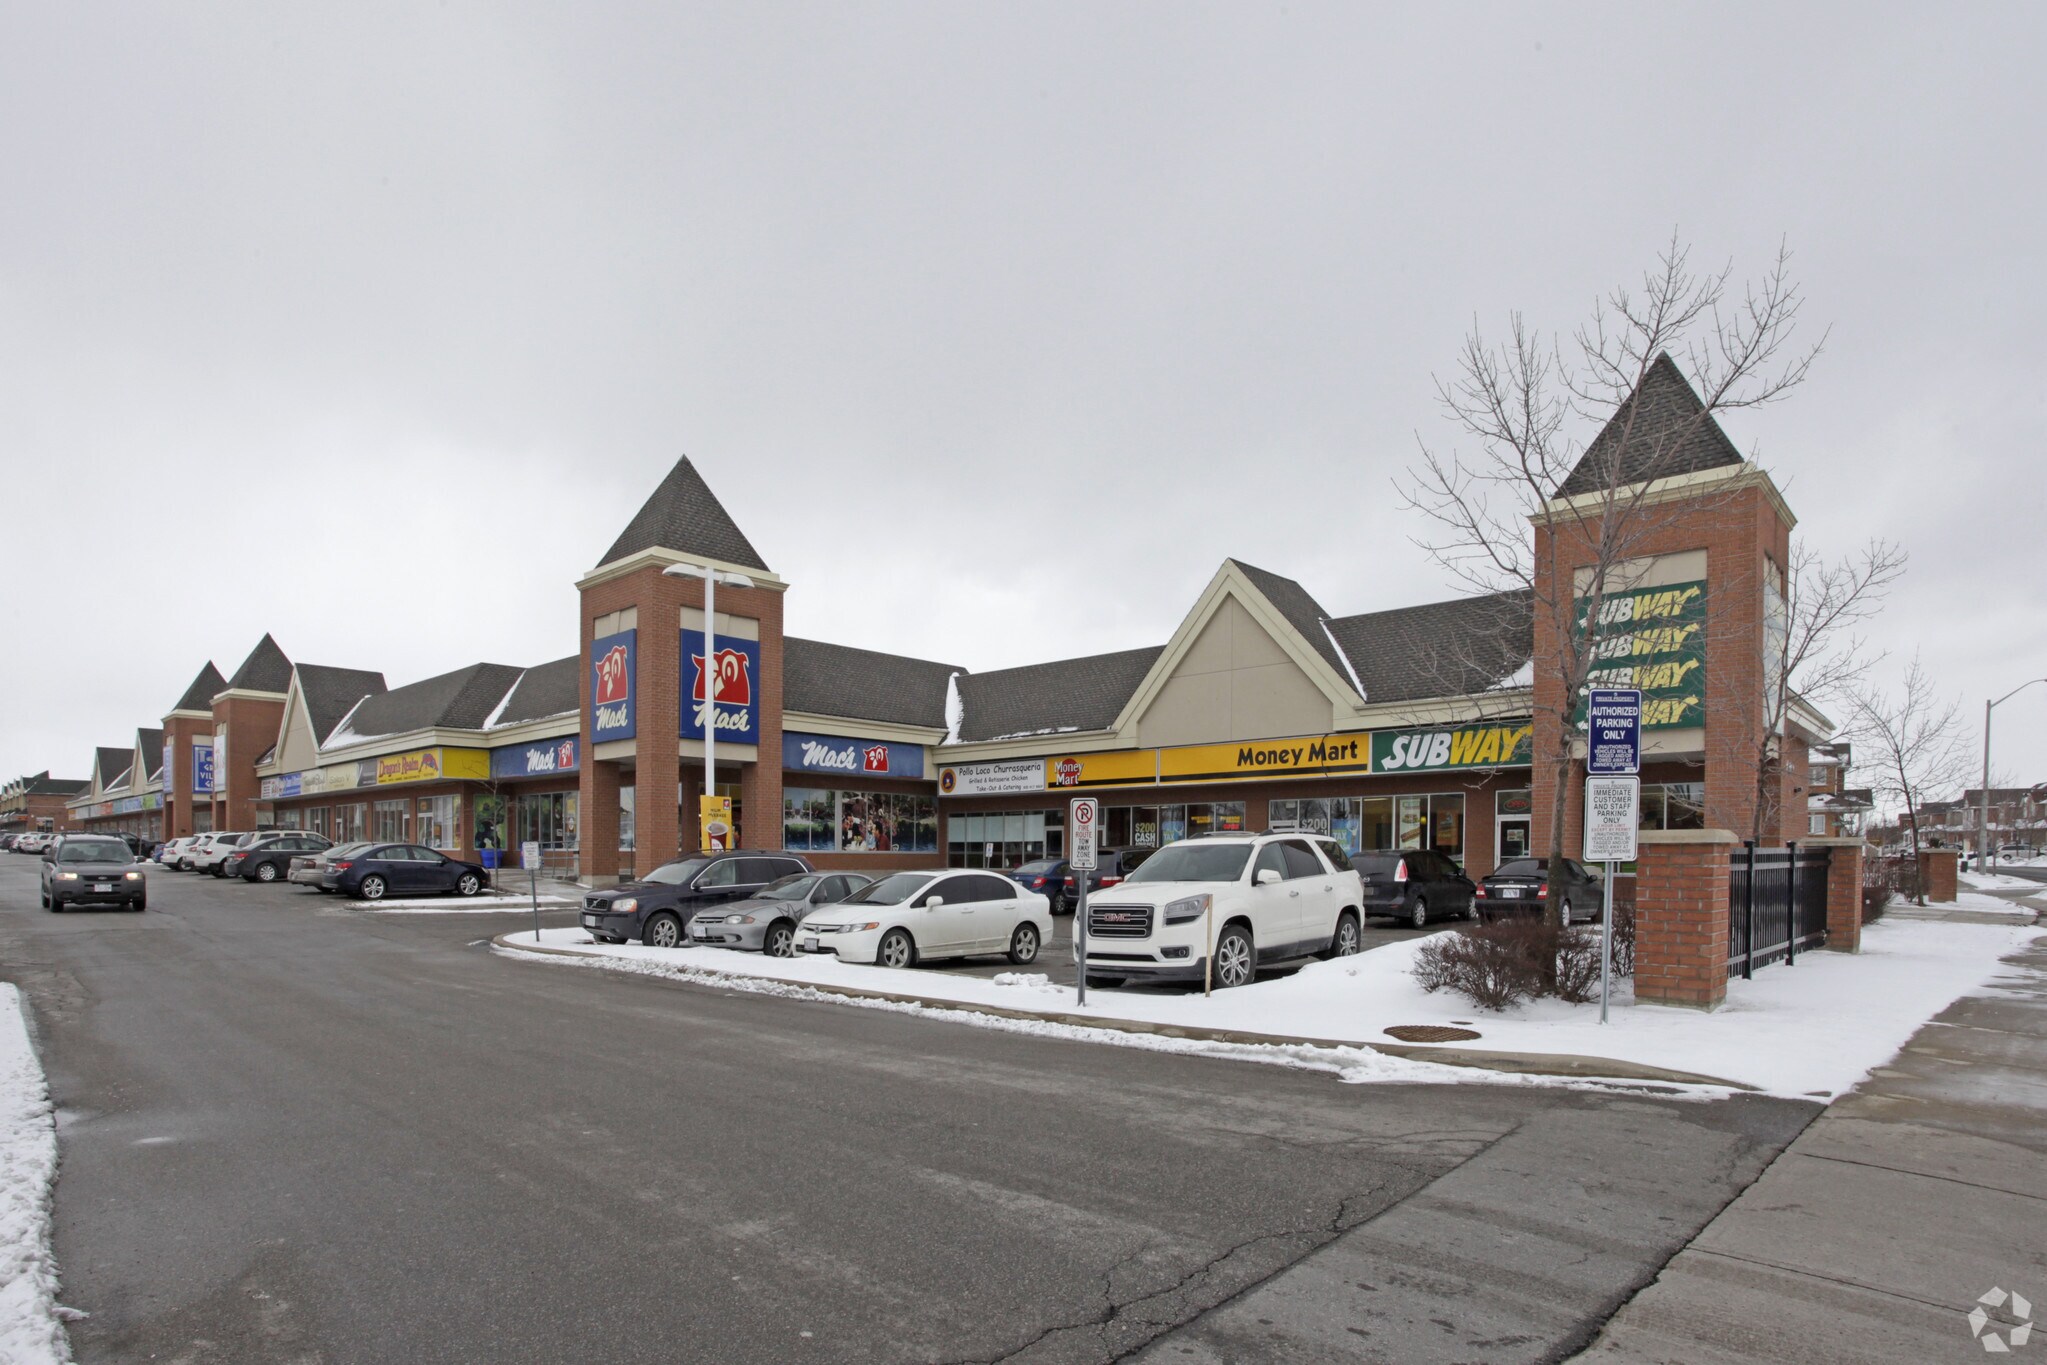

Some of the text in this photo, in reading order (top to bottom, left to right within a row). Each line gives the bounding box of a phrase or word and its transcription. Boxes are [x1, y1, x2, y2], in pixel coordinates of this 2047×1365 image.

[595, 703, 628, 731] Mac's
[692, 703, 750, 732] Mac's
[1592, 707, 1638, 716] AUTHORIZED
[1596, 719, 1633, 728] PARKING
[1603, 730, 1625, 739] ONLY
[1237, 740, 1358, 766] Money Mart
[1381, 724, 1533, 770] SUBWAY
[526, 747, 555, 772] Mac's
[801, 741, 857, 770] Mac's
[401, 756, 419, 774] Realm
[959, 762, 1041, 776] Pollo Loco Churrasqueria
[1054, 761, 1084, 777] Money
[1056, 773, 1079, 786] Mart
[1003, 783, 1022, 791] Catering
[1135, 822, 1155, 833] $200
[1302, 818, 1327, 830] $200
[1135, 833, 1156, 842] CASH
[1333, 832, 1347, 840] TAX
[1104, 913, 1130, 922] GMC
